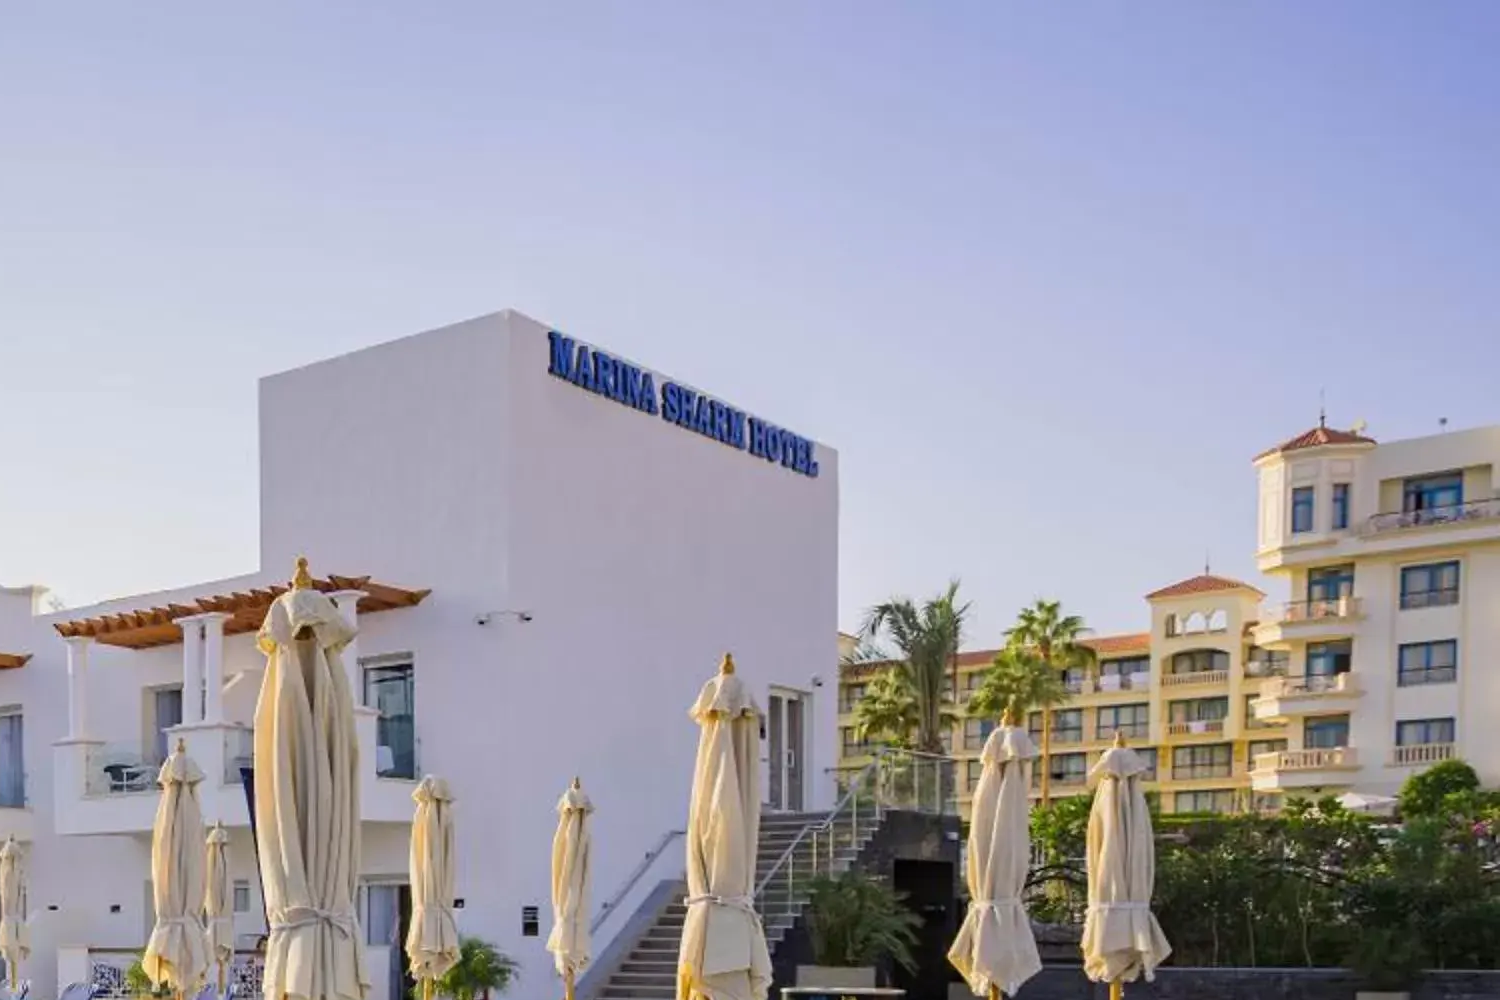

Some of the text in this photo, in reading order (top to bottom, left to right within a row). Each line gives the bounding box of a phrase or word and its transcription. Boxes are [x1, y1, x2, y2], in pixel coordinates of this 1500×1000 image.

[548, 331, 818, 478] MARINA SHARM HOTEL
